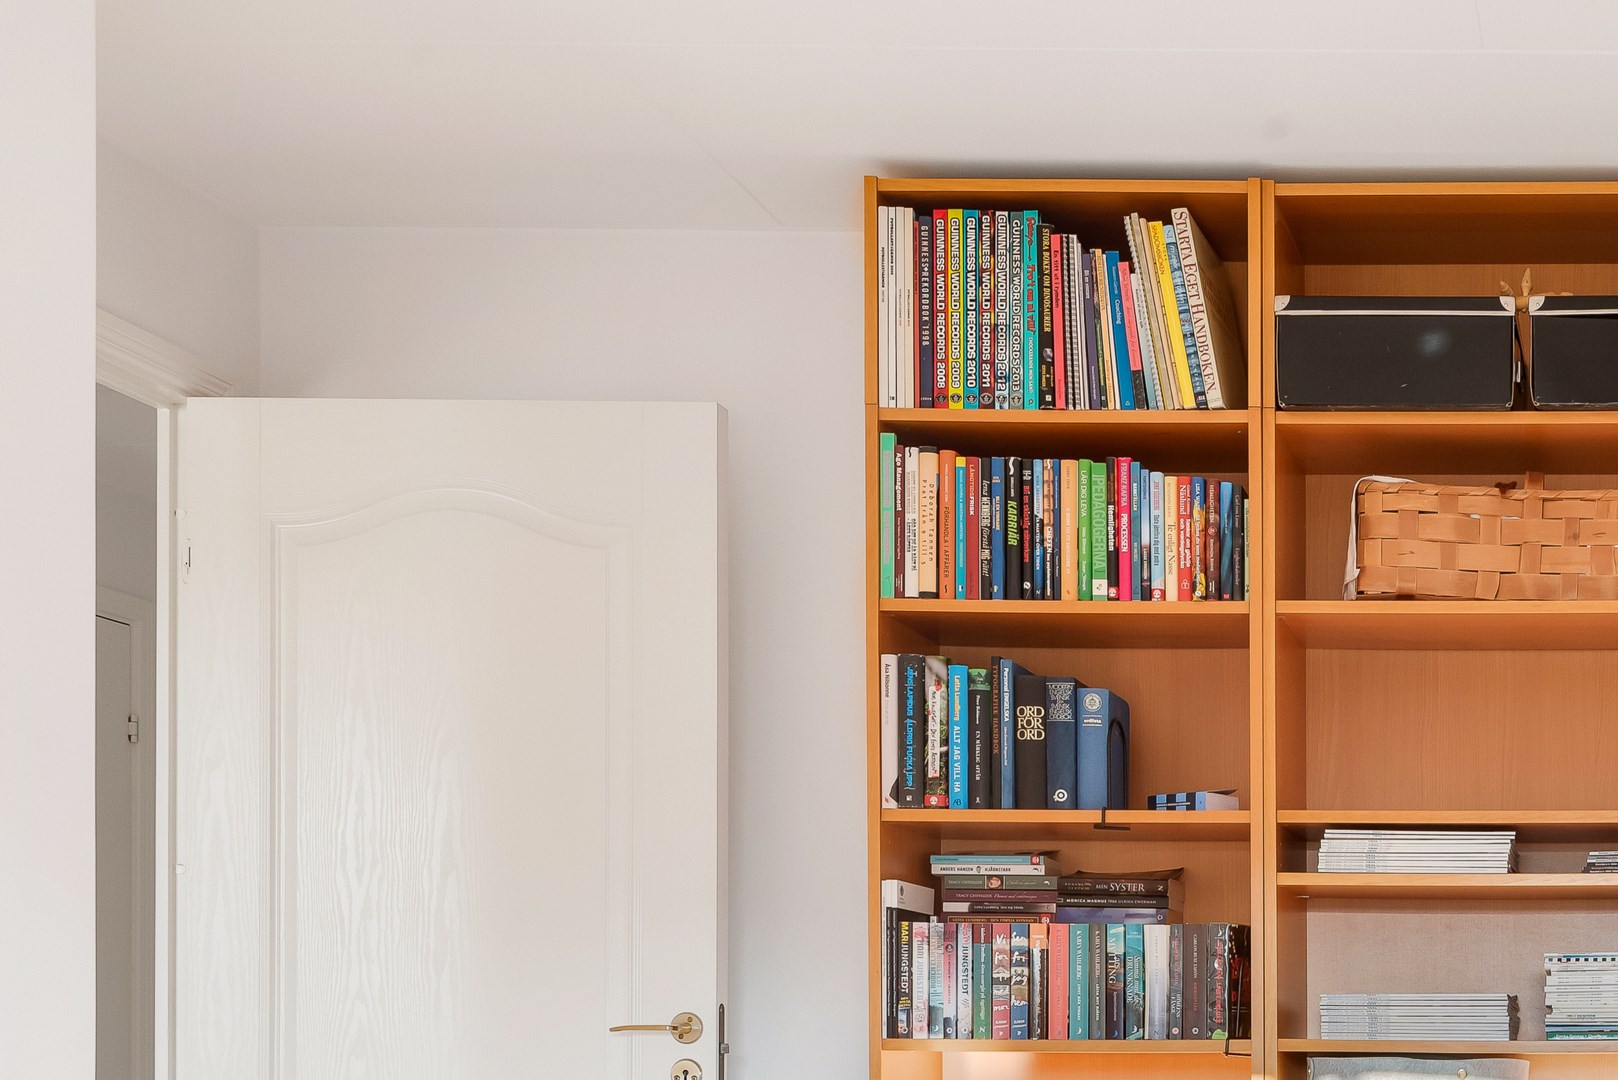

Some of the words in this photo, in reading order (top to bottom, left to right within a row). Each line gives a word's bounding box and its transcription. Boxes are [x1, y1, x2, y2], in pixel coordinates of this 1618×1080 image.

[921, 225, 930, 267] GUINNESS
[936, 218, 946, 271] GUINNESS
[951, 217, 961, 271] GUINNESS
[966, 217, 976, 270] GUINNESS
[981, 214, 992, 269] GUINNESS
[996, 214, 1007, 269] GUINNESS
[1011, 219, 1021, 274] GUINNESS
[1042, 228, 1050, 250] STORA
[1174, 211, 1192, 261] STARTA
[1183, 263, 1200, 300] EGET
[936, 273, 946, 310] WORLD
[951, 272, 961, 310] WORLD
[966, 271, 976, 310] WORLD
[981, 271, 992, 310] WORLD
[996, 271, 1007, 310] WORLD
[1011, 276, 1021, 313] WORLD
[1043, 275, 1051, 286] OM
[921, 271, 930, 321] REKORDBOK
[1044, 288, 1052, 332] DINOSAURIER
[1054, 286, 1062, 309] rymden
[1115, 299, 1123, 325] Coaching
[936, 312, 946, 360] RECORDS
[951, 311, 961, 359] RECORDS
[966, 310, 976, 359] RECORDS
[981, 311, 992, 361] RECORDS
[996, 311, 1007, 361] RECORDS
[1011, 315, 1021, 365] RECORDS
[936, 361, 946, 389] 2008
[951, 361, 961, 389] 2009
[966, 359, 976, 388] 2010
[981, 362, 992, 388] 2011
[996, 362, 1007, 391] 2012
[1011, 366, 1021, 392] 2013
[894, 452, 902, 466] Ago
[894, 467, 902, 511] Management
[920, 479, 929, 500] Prat
[1179, 485, 1187, 515] Näslund
[920, 504, 929, 525] från
[942, 506, 951, 544] FÖRHANDLA
[1008, 500, 1019, 546] KARRIÄR
[1107, 504, 1116, 551] Hemligheten
[920, 539, 929, 556] till
[981, 549, 990, 560] MIG
[1165, 533, 1175, 553] enligt
[942, 549, 951, 579] AFFÄRER
[981, 560, 990, 577] rätt!
[1167, 555, 1177, 575] Nasse
[906, 666, 915, 685] JENS
[906, 686, 915, 716] LAPIDUS
[1016, 706, 1045, 718] ORD
[906, 719, 915, 745] ALDRIG
[975, 730, 982, 738] EN
[1017, 729, 1046, 741] ORD
[1018, 715, 1045, 730] FÖR
[954, 781, 961, 793] HA
[1109, 882, 1145, 892] SYSTER
[916, 939, 925, 958] MARI
[900, 944, 909, 994] JUNGSTEDT
[916, 960, 925, 1004] JUNGSTEDT
[961, 945, 970, 996] JUNGSTEDT
[1126, 955, 1134, 1004] DRUNKNADE
[1134, 955, 1142, 979] Simma
[1134, 980, 1142, 994] med
